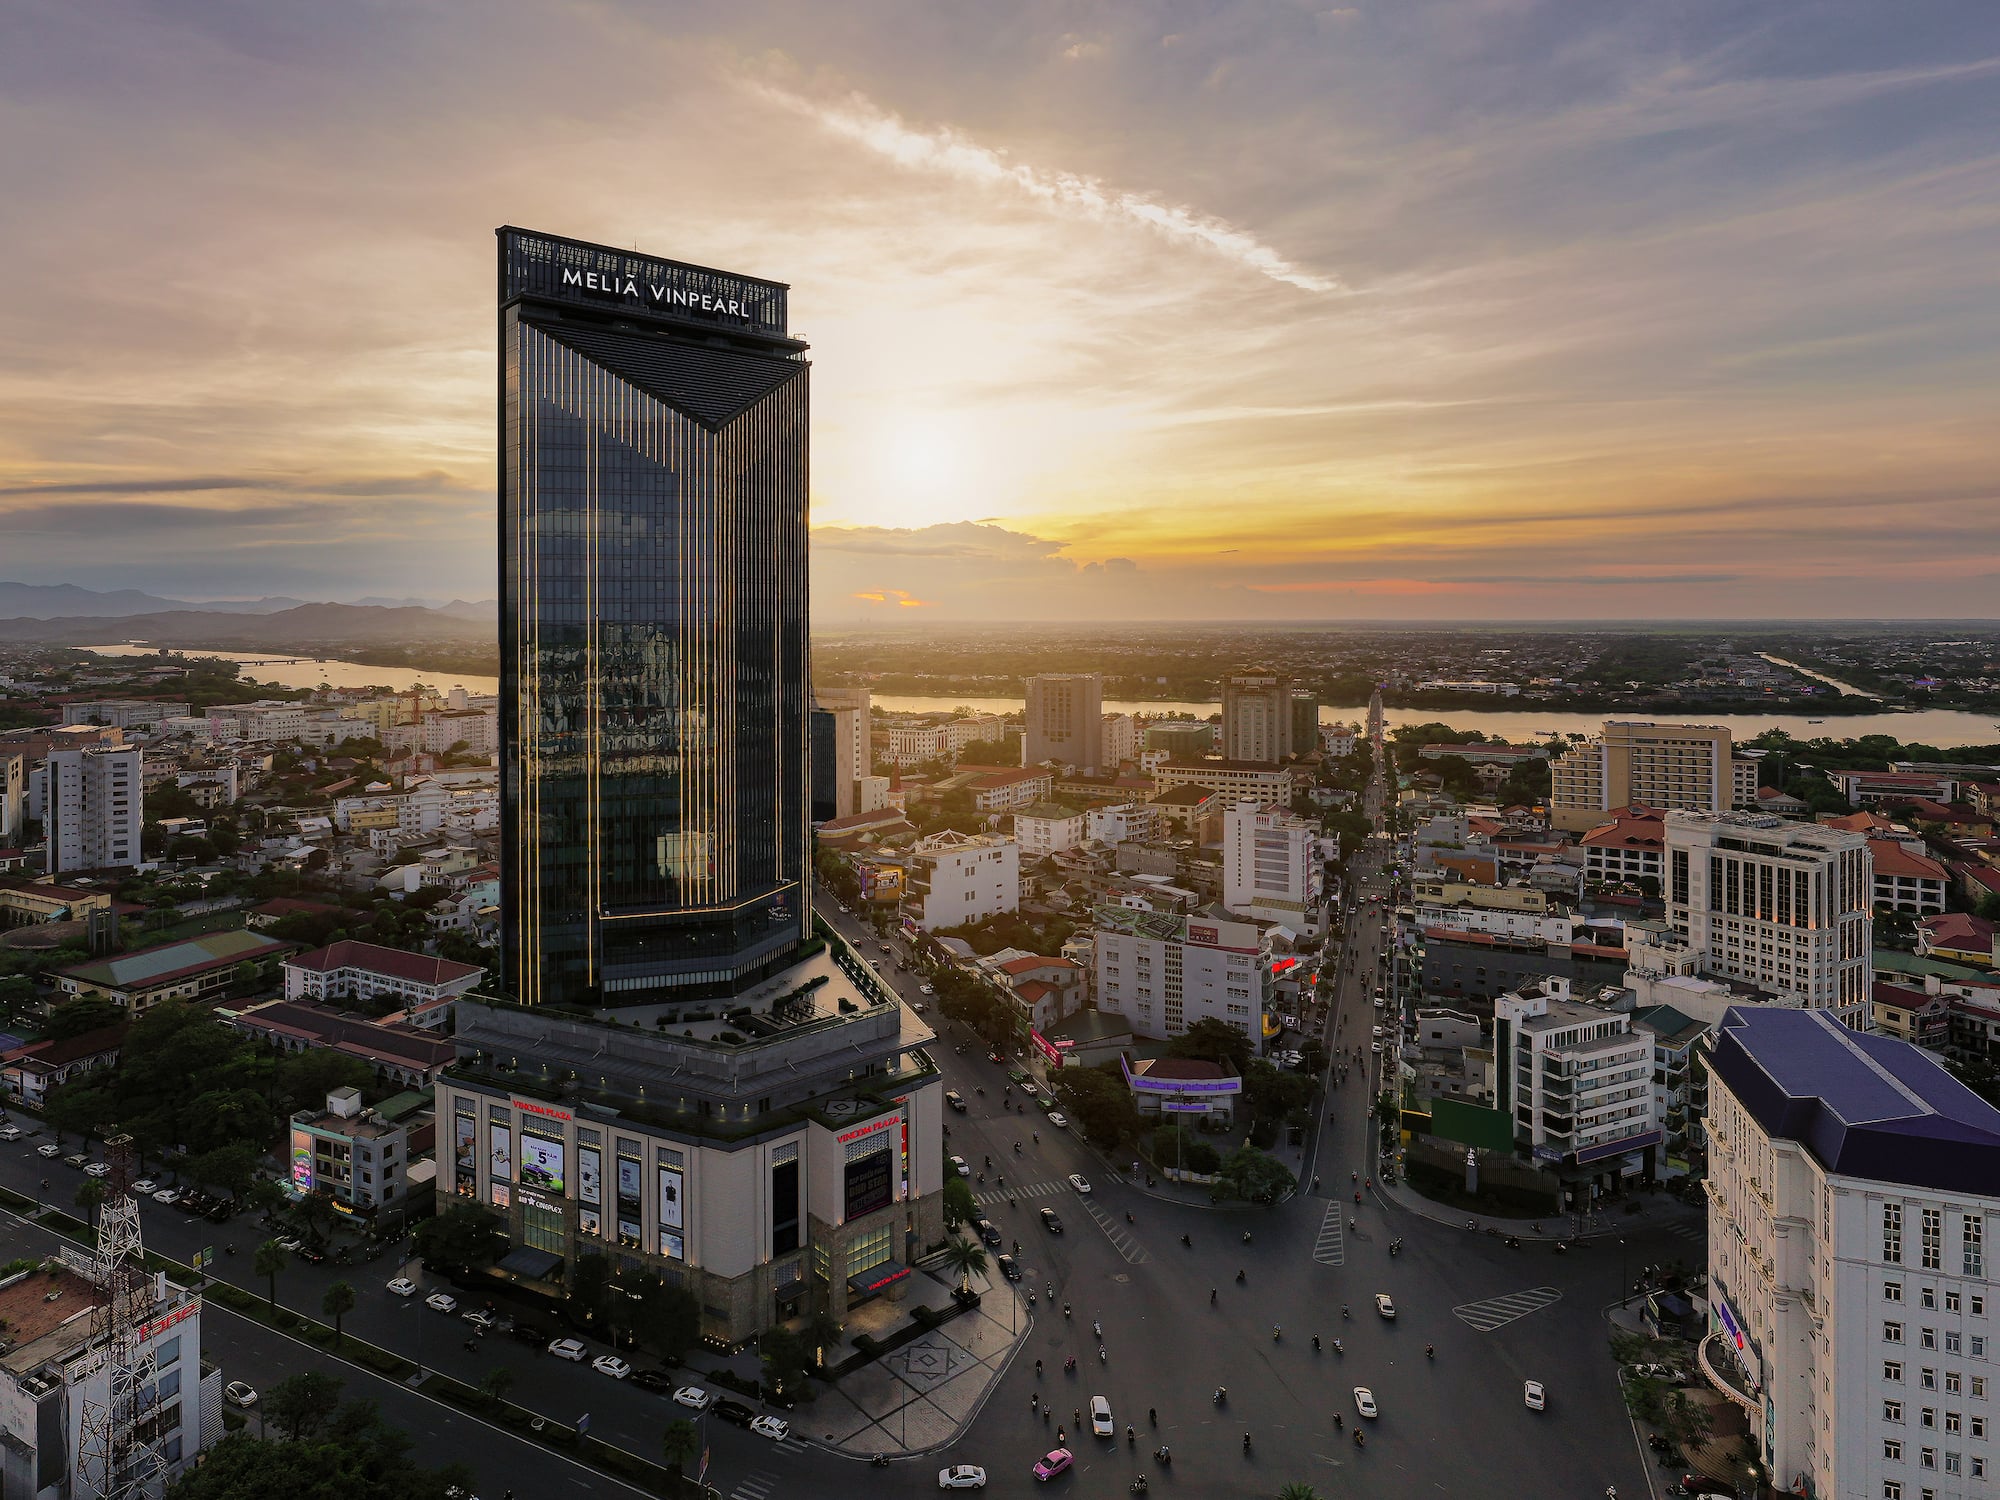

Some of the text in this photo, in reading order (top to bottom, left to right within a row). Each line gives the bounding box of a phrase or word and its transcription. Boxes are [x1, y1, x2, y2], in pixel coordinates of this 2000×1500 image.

[650, 284, 750, 318] VINPEARL
[512, 1100, 572, 1121] VINCOM PLAZA
[837, 1115, 900, 1144] VINCOM PLAZA
[538, 1151, 547, 1164] 5
[535, 1201, 563, 1215] CINEPLEX
[867, 1276, 892, 1291] VINCOM
